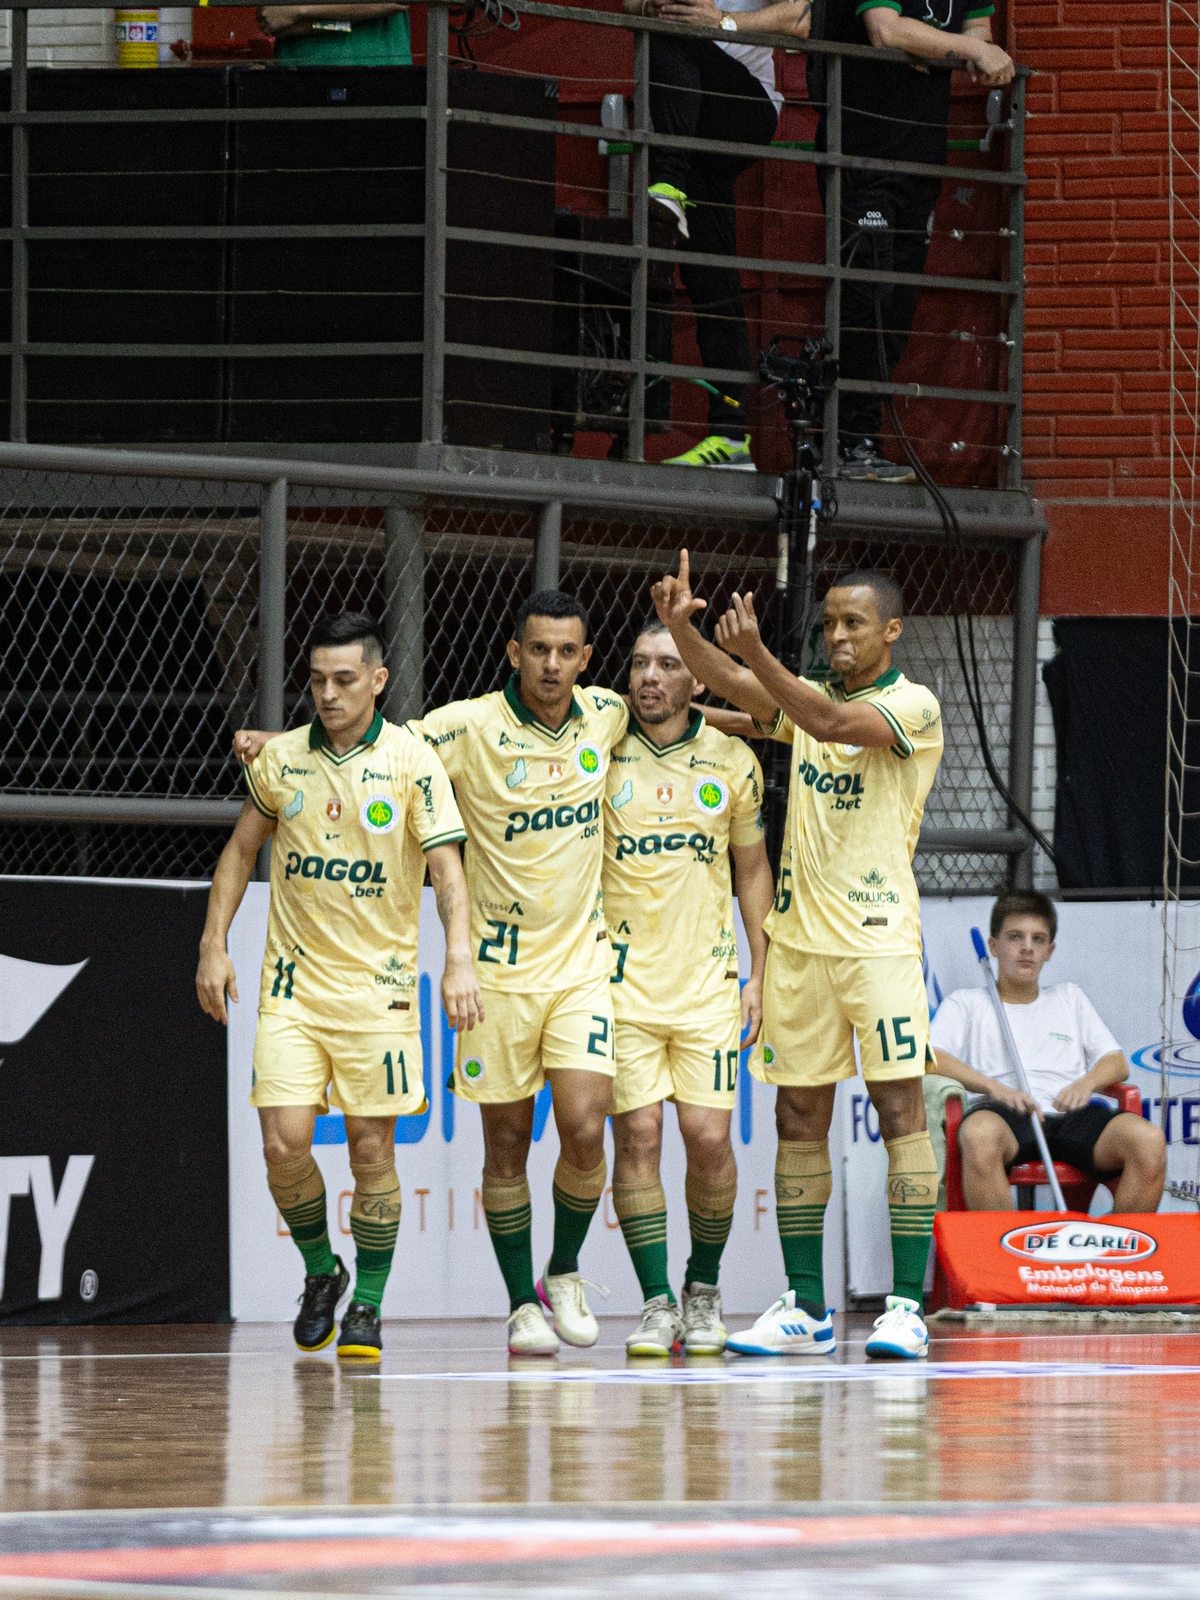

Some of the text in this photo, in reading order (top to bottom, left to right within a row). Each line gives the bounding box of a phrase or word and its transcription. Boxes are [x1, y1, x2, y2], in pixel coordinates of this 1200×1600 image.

[478, 919, 520, 965] 21
[271, 956, 296, 1000] 11
[876, 1016, 917, 1062] 15
[382, 1050, 409, 1095] 11
[713, 1049, 738, 1091] 10
[1027, 1233, 1138, 1251] DE CARLI
[1018, 1263, 1165, 1283] Embalagens
[1027, 1280, 1169, 1297] Material de Limpeza
